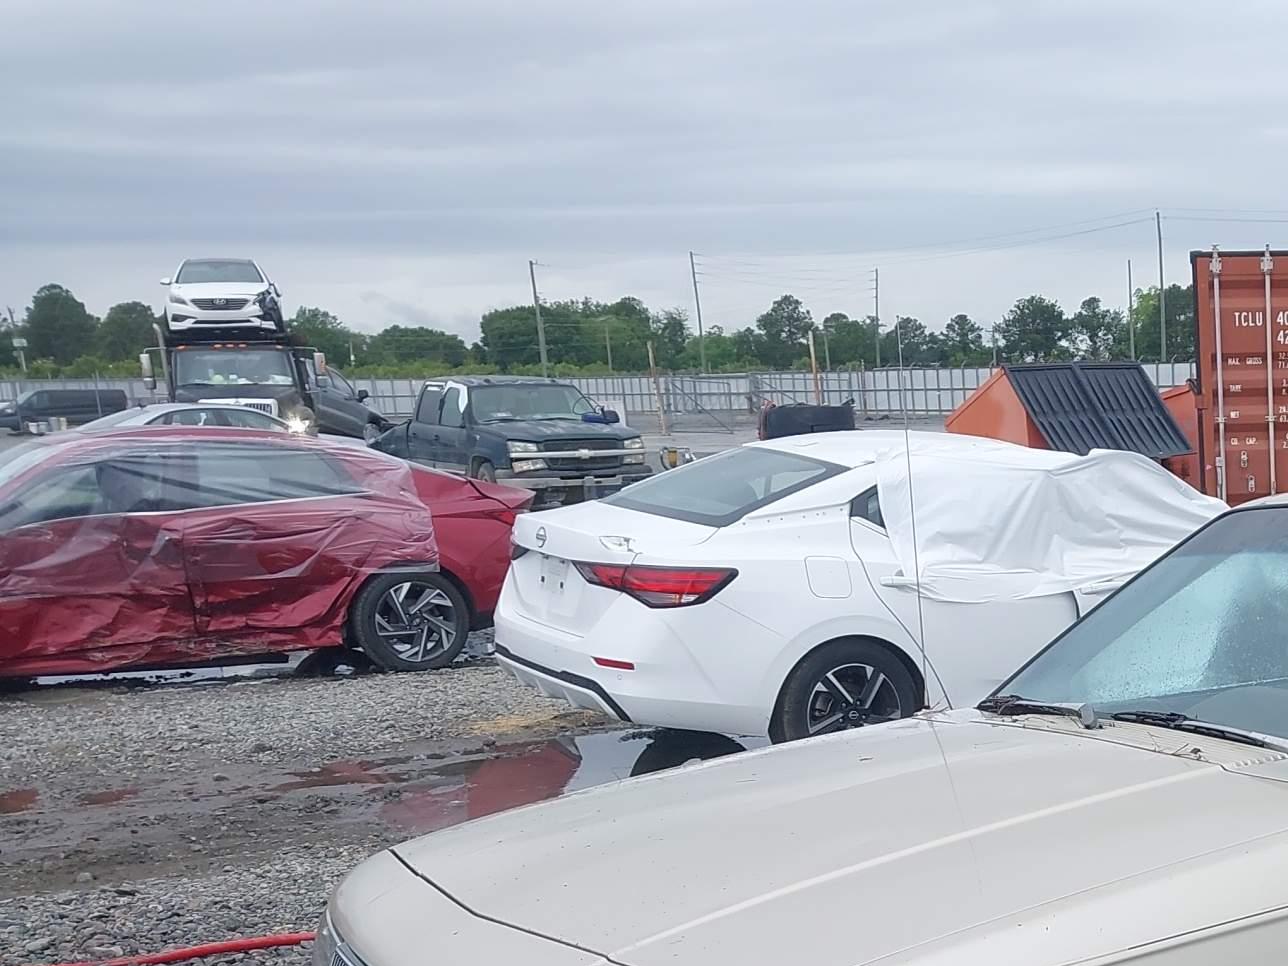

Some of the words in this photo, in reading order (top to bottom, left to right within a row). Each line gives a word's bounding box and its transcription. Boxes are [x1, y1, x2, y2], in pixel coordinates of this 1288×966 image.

[1233, 311, 1263, 327] TCLU
[1246, 356, 1263, 365] GROSS
[1229, 384, 1242, 392] TARE
[1230, 410, 1240, 419] NET
